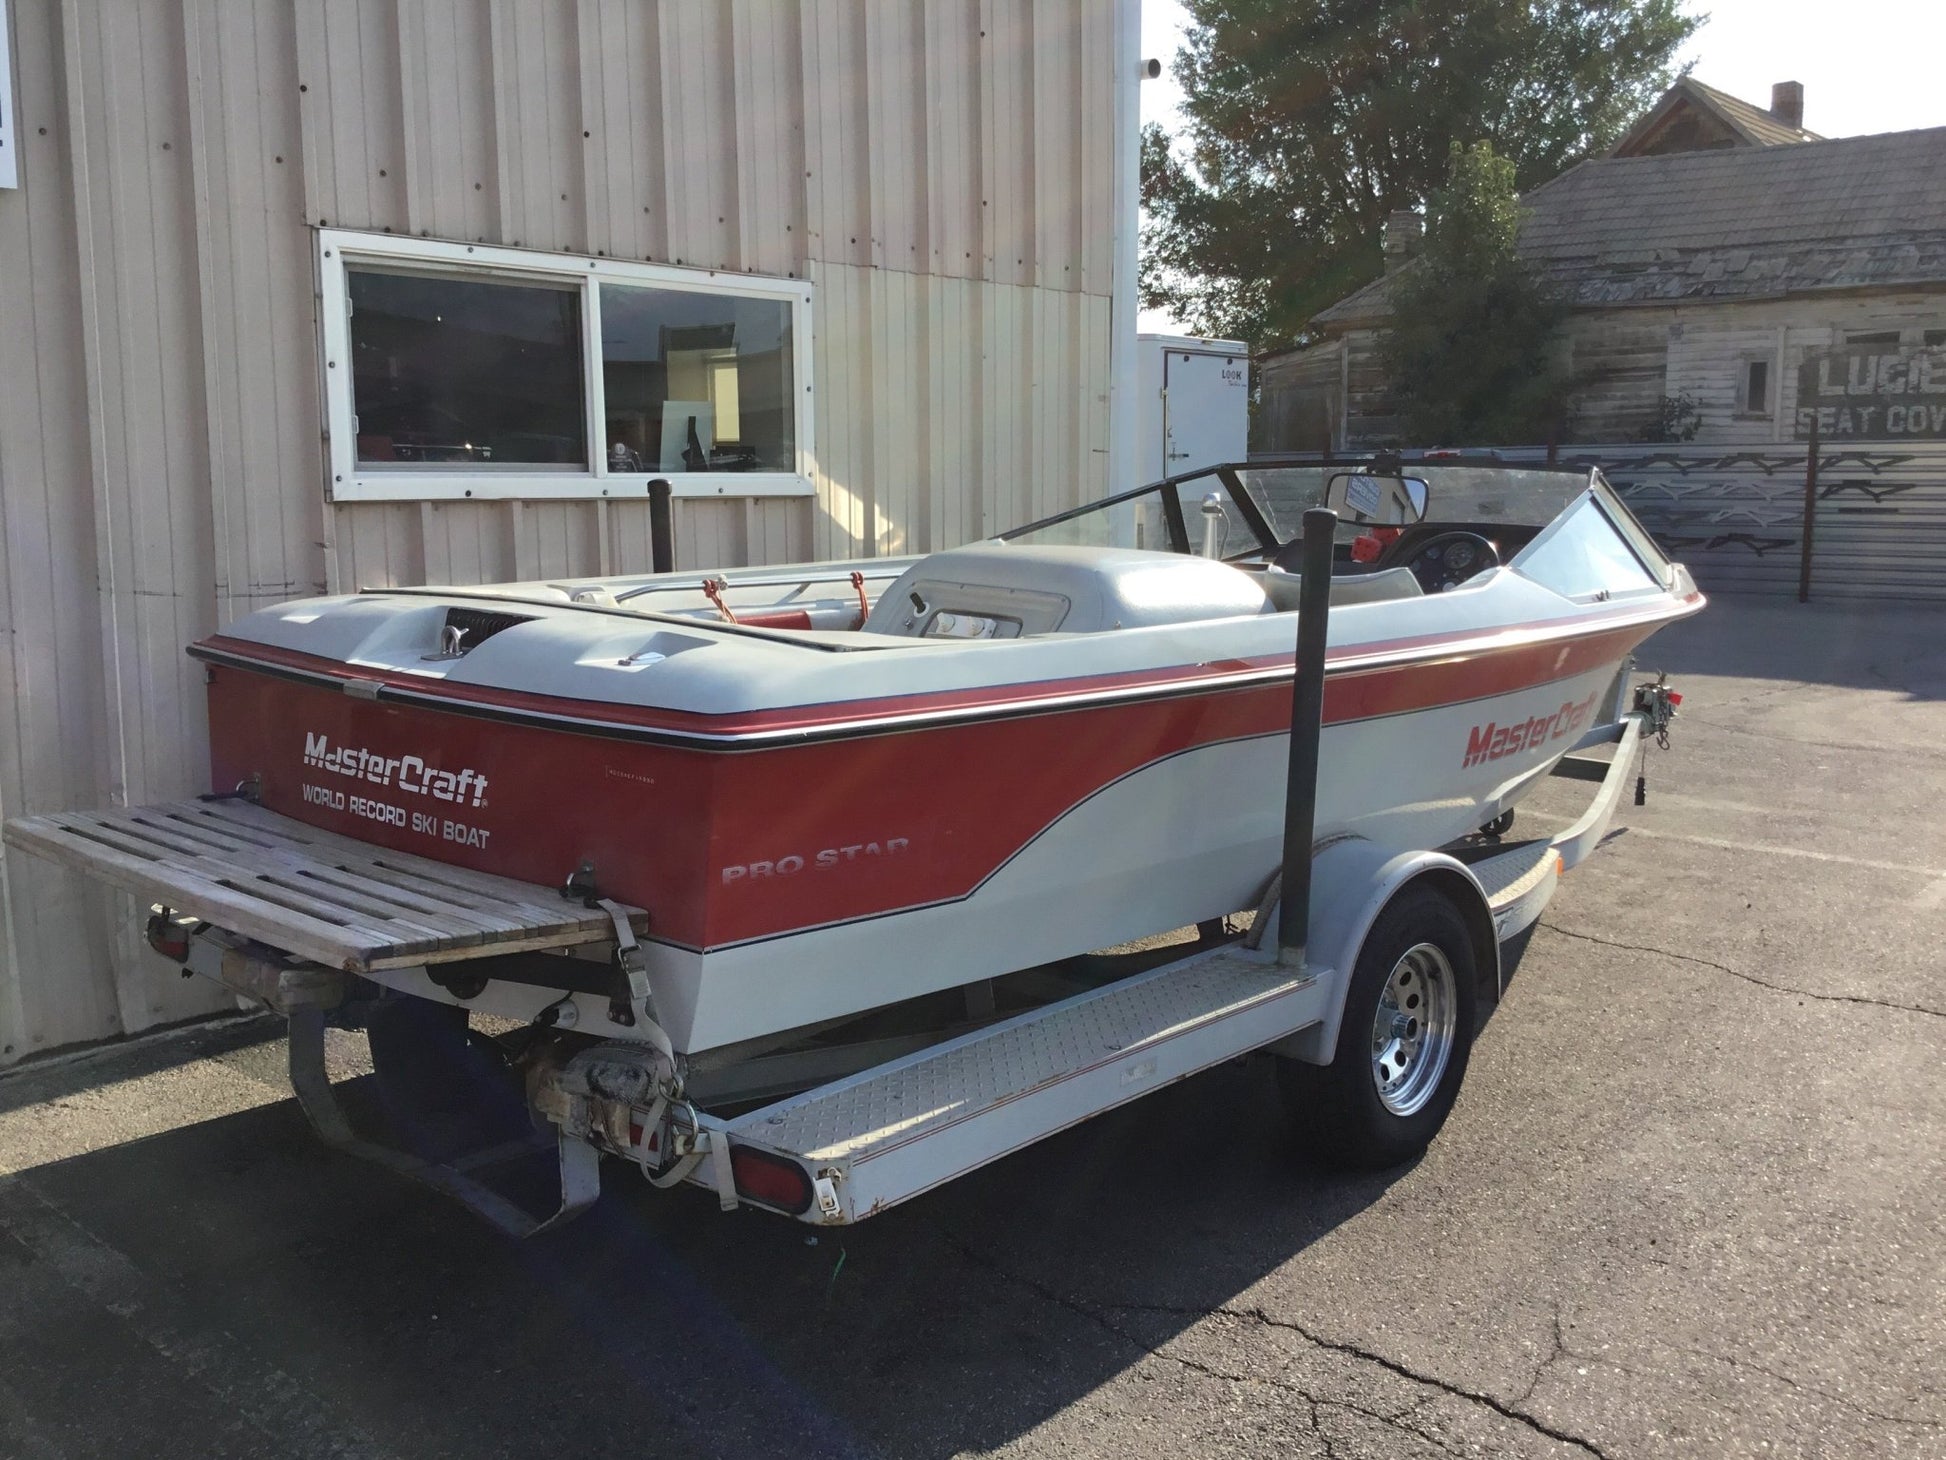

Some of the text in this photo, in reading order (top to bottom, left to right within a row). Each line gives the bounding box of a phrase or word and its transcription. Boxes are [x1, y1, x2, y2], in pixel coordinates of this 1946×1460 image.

[1222, 369, 1242, 380] LOOK
[1796, 404, 1946, 433] SEAT COV
[303, 732, 488, 807] MasterCraft
[303, 783, 490, 849] WORLD RECORD SKI BOAT
[722, 855, 804, 886] PRO
